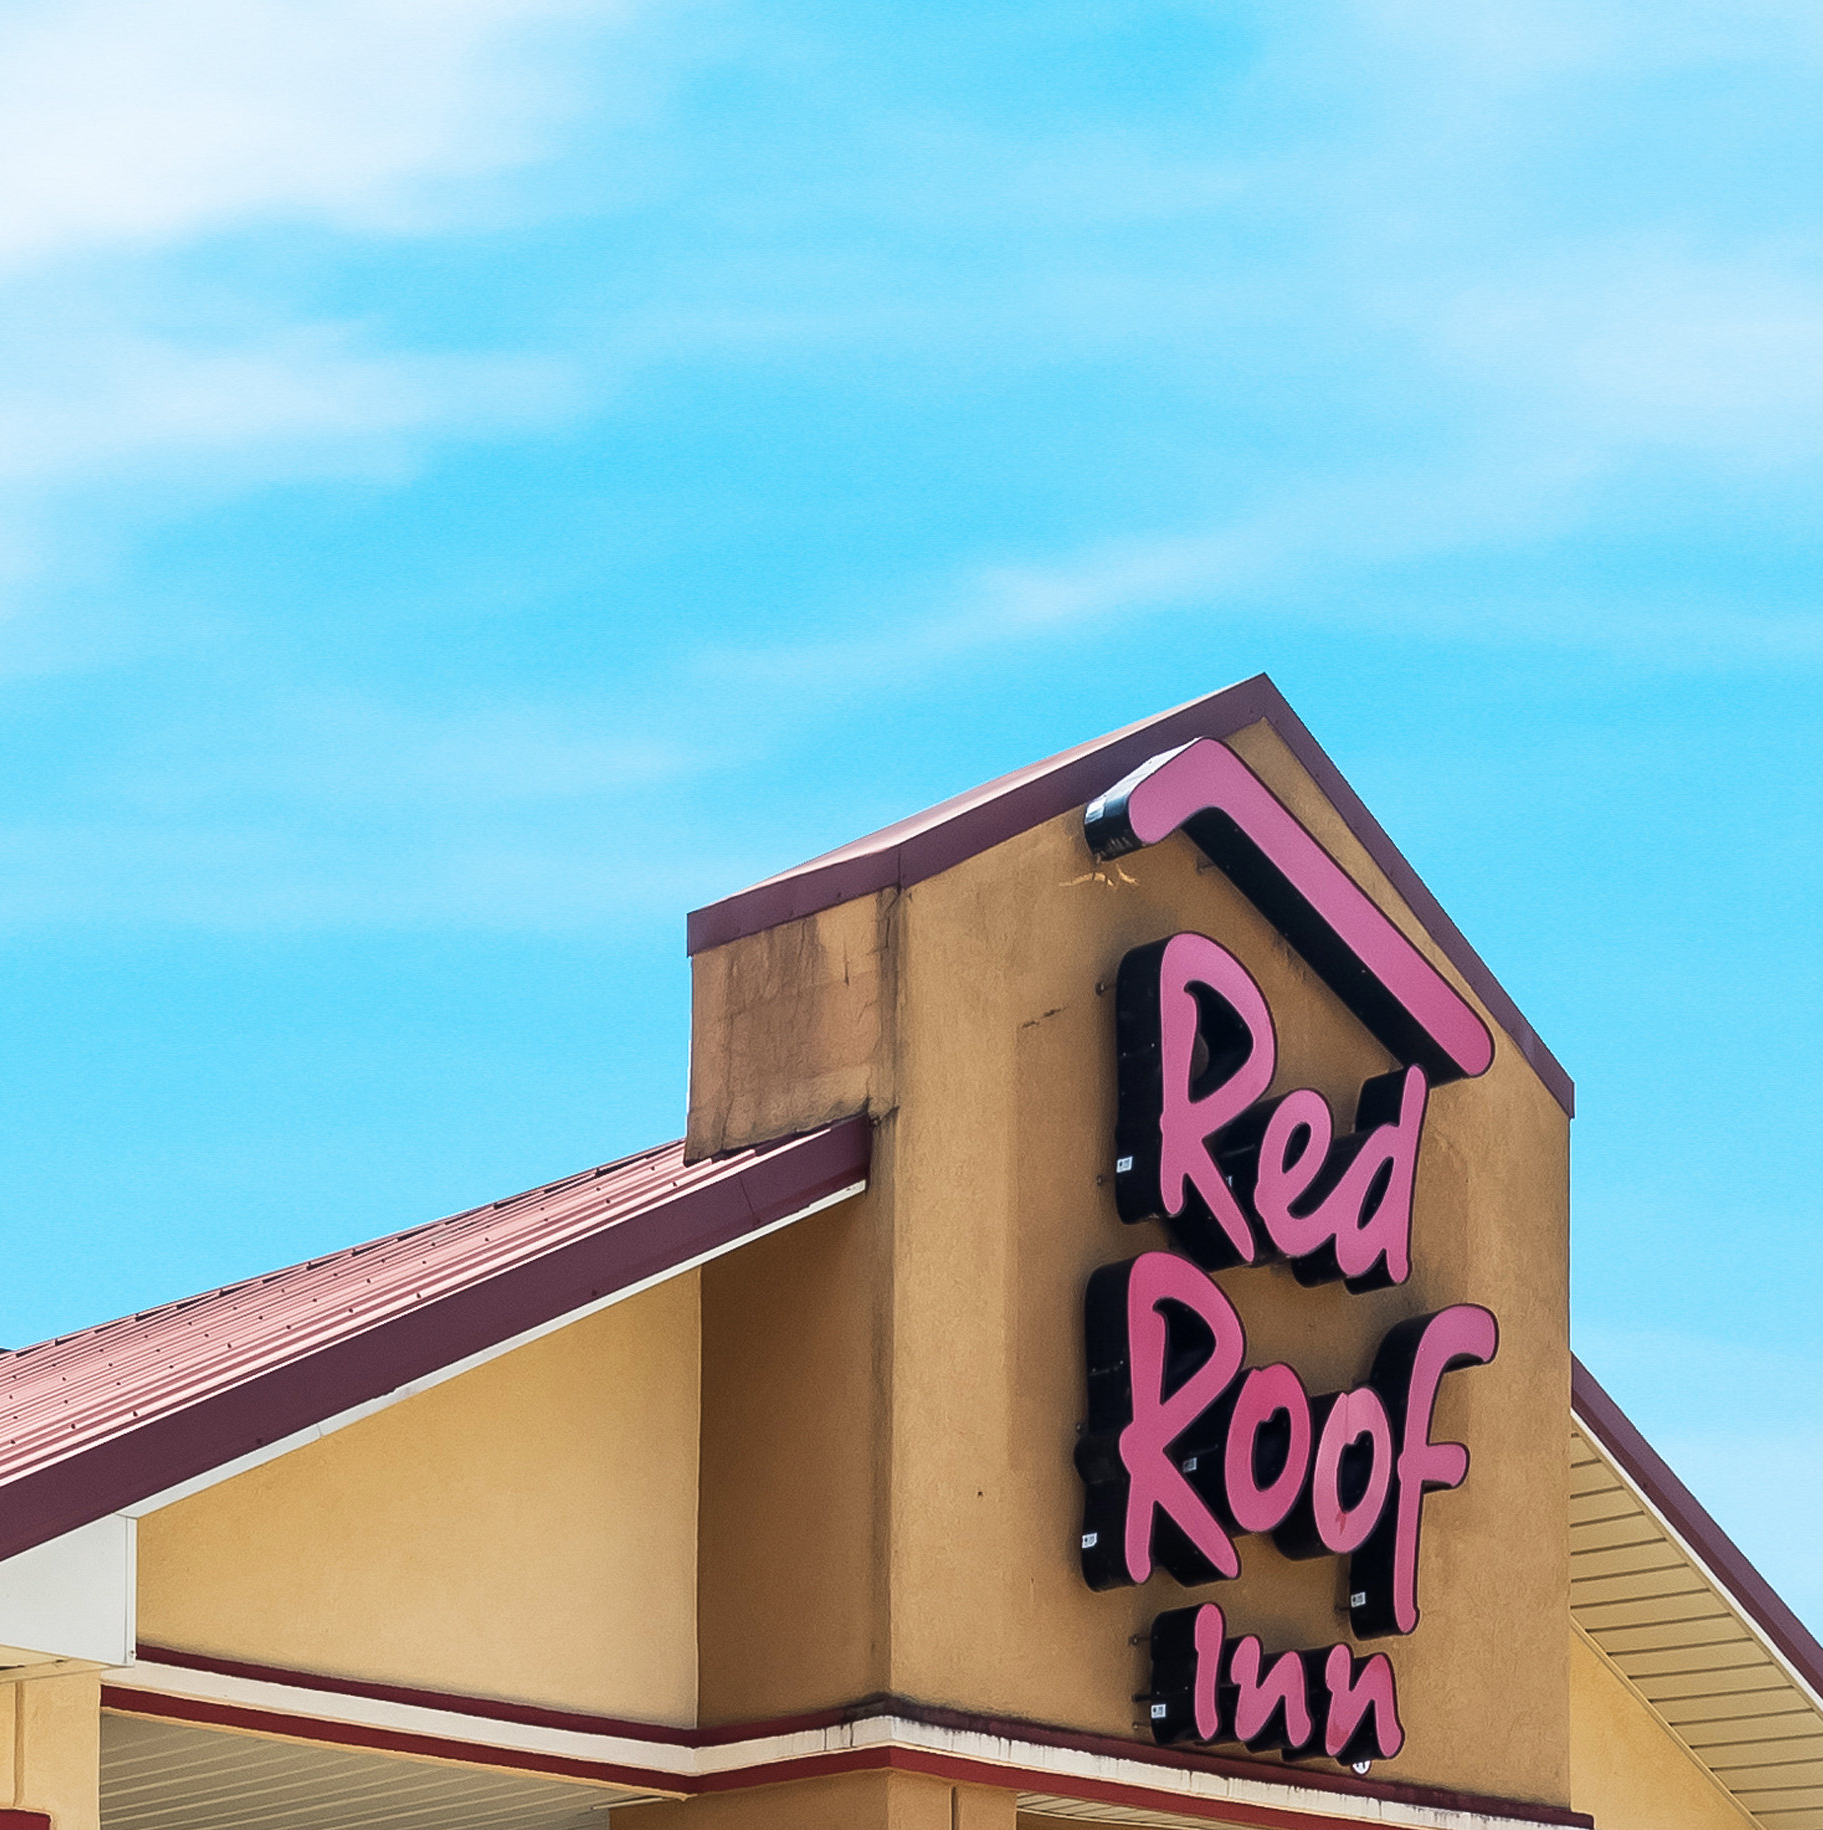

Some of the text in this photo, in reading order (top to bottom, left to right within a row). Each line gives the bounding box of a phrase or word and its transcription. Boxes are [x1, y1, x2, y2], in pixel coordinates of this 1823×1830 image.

[1158, 932, 1427, 1284] Red
[1118, 1250, 1497, 1634] Roof
[1193, 1603, 1403, 1758] Inn
